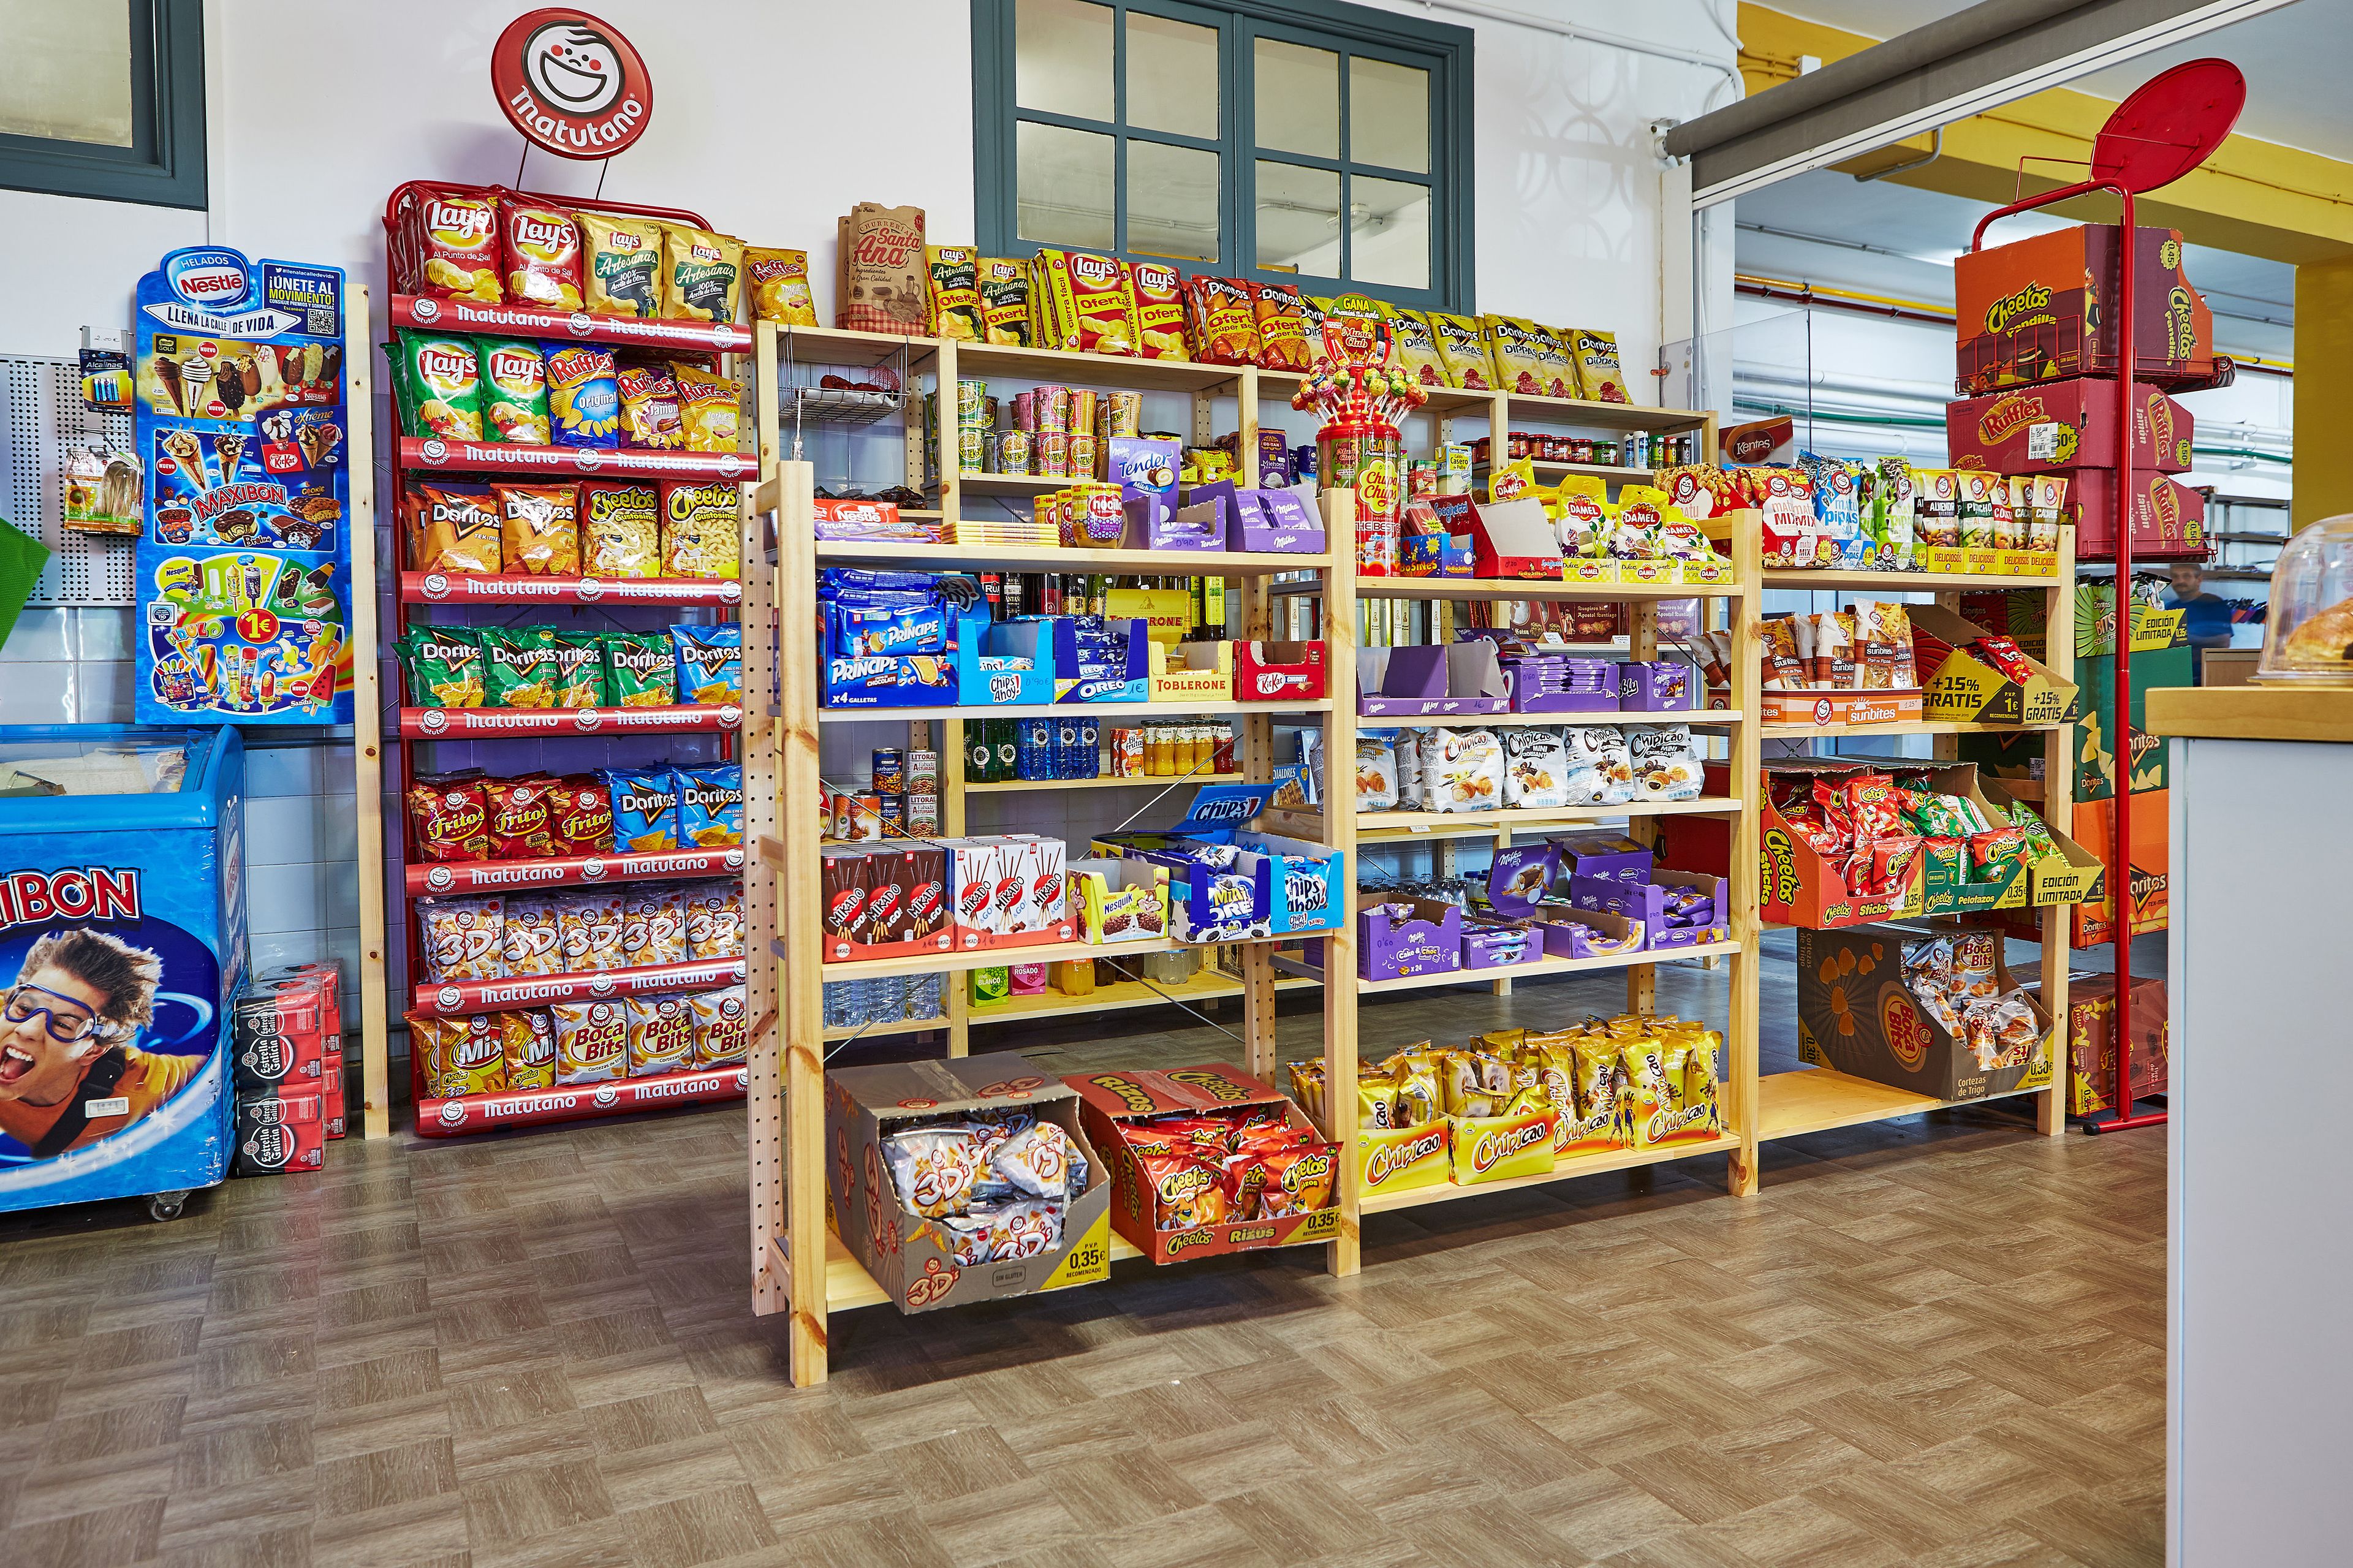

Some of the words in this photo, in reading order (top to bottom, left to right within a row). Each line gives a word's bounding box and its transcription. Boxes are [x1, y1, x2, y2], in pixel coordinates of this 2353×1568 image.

[517, 216, 573, 254] Lay's
[612, 232, 640, 250] Lay's
[877, 227, 920, 249] Santa
[442, 251, 466, 260] Punto
[693, 245, 720, 262] Lay's
[853, 235, 907, 265] Ana
[941, 250, 965, 264] Lay's
[181, 257, 229, 268] HELADOS
[993, 263, 1016, 278] Lay's
[1076, 256, 1116, 282] Lay's
[620, 269, 637, 281] 100%
[749, 260, 804, 282] Ruffles
[181, 273, 243, 294] Nestlé
[319, 281, 334, 294] AL
[699, 281, 714, 290] 100%
[1061, 276, 1070, 298] fácil
[1140, 269, 1176, 292] Lay's
[269, 289, 335, 305] MOVIMIENTO!
[1208, 282, 1249, 300] Doritos
[1333, 307, 1355, 316] Premios
[1343, 297, 1370, 312] GANA
[1985, 286, 2052, 333] Cheetos
[167, 306, 199, 325] LLENA
[201, 314, 209, 327] LA
[210, 317, 227, 331] CALLE
[233, 320, 243, 333] DE
[246, 315, 275, 331] VIDA
[2170, 287, 2193, 360] Cheetos
[1342, 327, 1373, 339] Music
[1441, 325, 1480, 341] Doritos
[1498, 325, 1536, 343] Doritos
[1346, 337, 1368, 347] Club
[1580, 339, 1618, 353] Doritos
[424, 350, 477, 383] Lay's
[495, 353, 544, 386] Lay's
[548, 350, 614, 384] Ruffles
[617, 374, 675, 399] Ruffles
[579, 392, 616, 409] Original
[650, 403, 678, 417] Jamón
[1981, 398, 2044, 439] Ruffles
[2153, 397, 2170, 459] Ruffles
[1736, 437, 1770, 453] Kentes
[1118, 452, 1173, 478] Tender
[1450, 457, 1468, 466] Casero
[1132, 481, 1150, 492] Milch
[1366, 471, 1397, 488] Chupa
[192, 483, 285, 522] MAXIBON
[669, 483, 737, 522] Cheetos
[1364, 485, 1396, 507] Chups
[590, 487, 657, 523] Cheetos
[1090, 498, 1123, 512] nocilla
[1276, 502, 1300, 513] Milka
[1570, 506, 1599, 516] DAMEL
[1624, 513, 1656, 524] DAMEL
[1273, 535, 1298, 548] Milka
[1934, 553, 1961, 562] DELICIOSOS
[1969, 555, 1995, 564] DELICIOSOS
[2005, 556, 2029, 565] DELICIOSOS
[2031, 557, 2056, 566] DELICIOSOS
[166, 566, 189, 577] Nesquik
[244, 613, 271, 639] 1€
[2146, 615, 2174, 628] EDICIÓN
[2136, 629, 2172, 640] LIMITADA
[682, 646, 741, 663] Doritos
[1866, 647, 1893, 656] sunbites
[614, 652, 675, 668] Doritos
[867, 677, 896, 687] CHOCOLATE
[990, 676, 1015, 692] Chips
[1156, 679, 1226, 692] TOBLERONE
[1933, 676, 1979, 691] +15%
[832, 692, 848, 704] x4
[1922, 693, 1983, 708] GRATIS
[2005, 699, 2018, 712] 1€
[2034, 692, 2059, 705] +15%
[2026, 707, 2061, 721] GRATIS
[1445, 733, 1488, 763] Chipicao
[1507, 732, 1550, 758] Chipicao
[1629, 732, 1684, 759] Chipicao
[1522, 751, 1547, 759] CROISSANT
[1645, 750, 1675, 759] CROISSANT
[684, 788, 743, 804] Doritos
[427, 810, 485, 841] Fritos
[494, 808, 548, 833] Fritos
[1498, 850, 1523, 866] Milka
[1987, 838, 2019, 862] Cheetos
[2042, 876, 2079, 887] EDICIÓN
[1926, 890, 1954, 913] Cheetos
[1957, 895, 1995, 906] Pelotazos
[2037, 890, 2082, 903] LIMITADA
[1963, 944, 1993, 955] Boca
[1971, 954, 1993, 967] Bits
[978, 977, 1001, 987] BLANCO
[574, 1022, 624, 1047] Boca
[645, 1017, 691, 1040] Boca
[459, 1034, 503, 1064] Mix
[585, 1039, 624, 1061] Bits
[656, 1031, 691, 1053] Bits
[260, 1039, 270, 1074] Estrella
[270, 1040, 281, 1071] Galicia
[443, 1071, 469, 1085] Cheetos
[1958, 1076, 1986, 1088] Cortezas
[1968, 1085, 1985, 1096] Trigo
[1647, 1102, 1708, 1144] Chipicao
[262, 1129, 271, 1162] Estrella
[271, 1129, 282, 1159] Galicia
[1472, 1121, 1547, 1173] Chipicao
[1365, 1132, 1442, 1187] Chipicao
[1281, 1156, 1328, 1192] Cheetos
[1159, 1170, 1211, 1203] Cheetos
[1307, 1211, 1341, 1229] 0,35€
[1303, 1227, 1335, 1237] RECOMENDADO
[1069, 1250, 1105, 1269] 0,35€
[995, 1274, 1005, 1282] SIN
[1006, 1271, 1024, 1282] GLUTEN
[1066, 1268, 1102, 1278] RECOMENDADO
